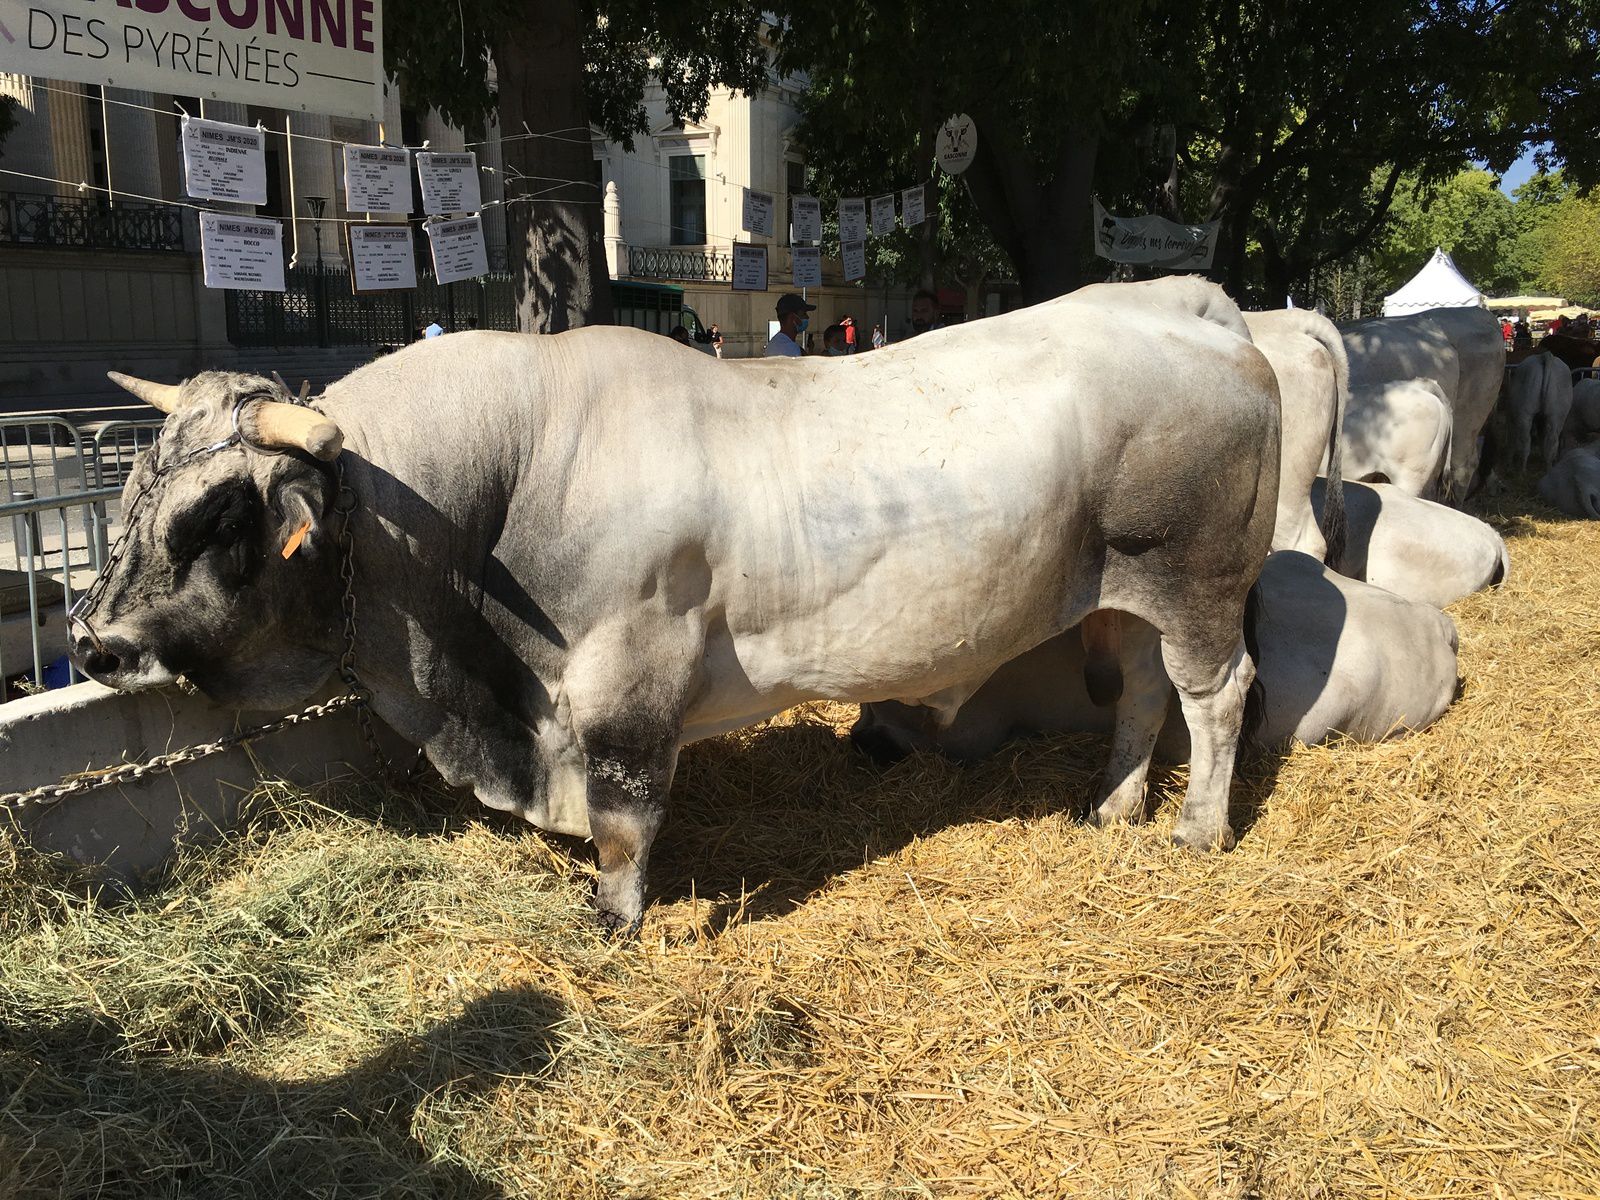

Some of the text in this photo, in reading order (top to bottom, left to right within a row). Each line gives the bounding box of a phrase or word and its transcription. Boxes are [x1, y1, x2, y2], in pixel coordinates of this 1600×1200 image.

[28, 8, 299, 88] DES PYRÉNÉES
[202, 131, 223, 141] NIMES
[243, 137, 257, 146] 2020
[219, 223, 241, 232] NIMES
[260, 227, 274, 236] 2020
